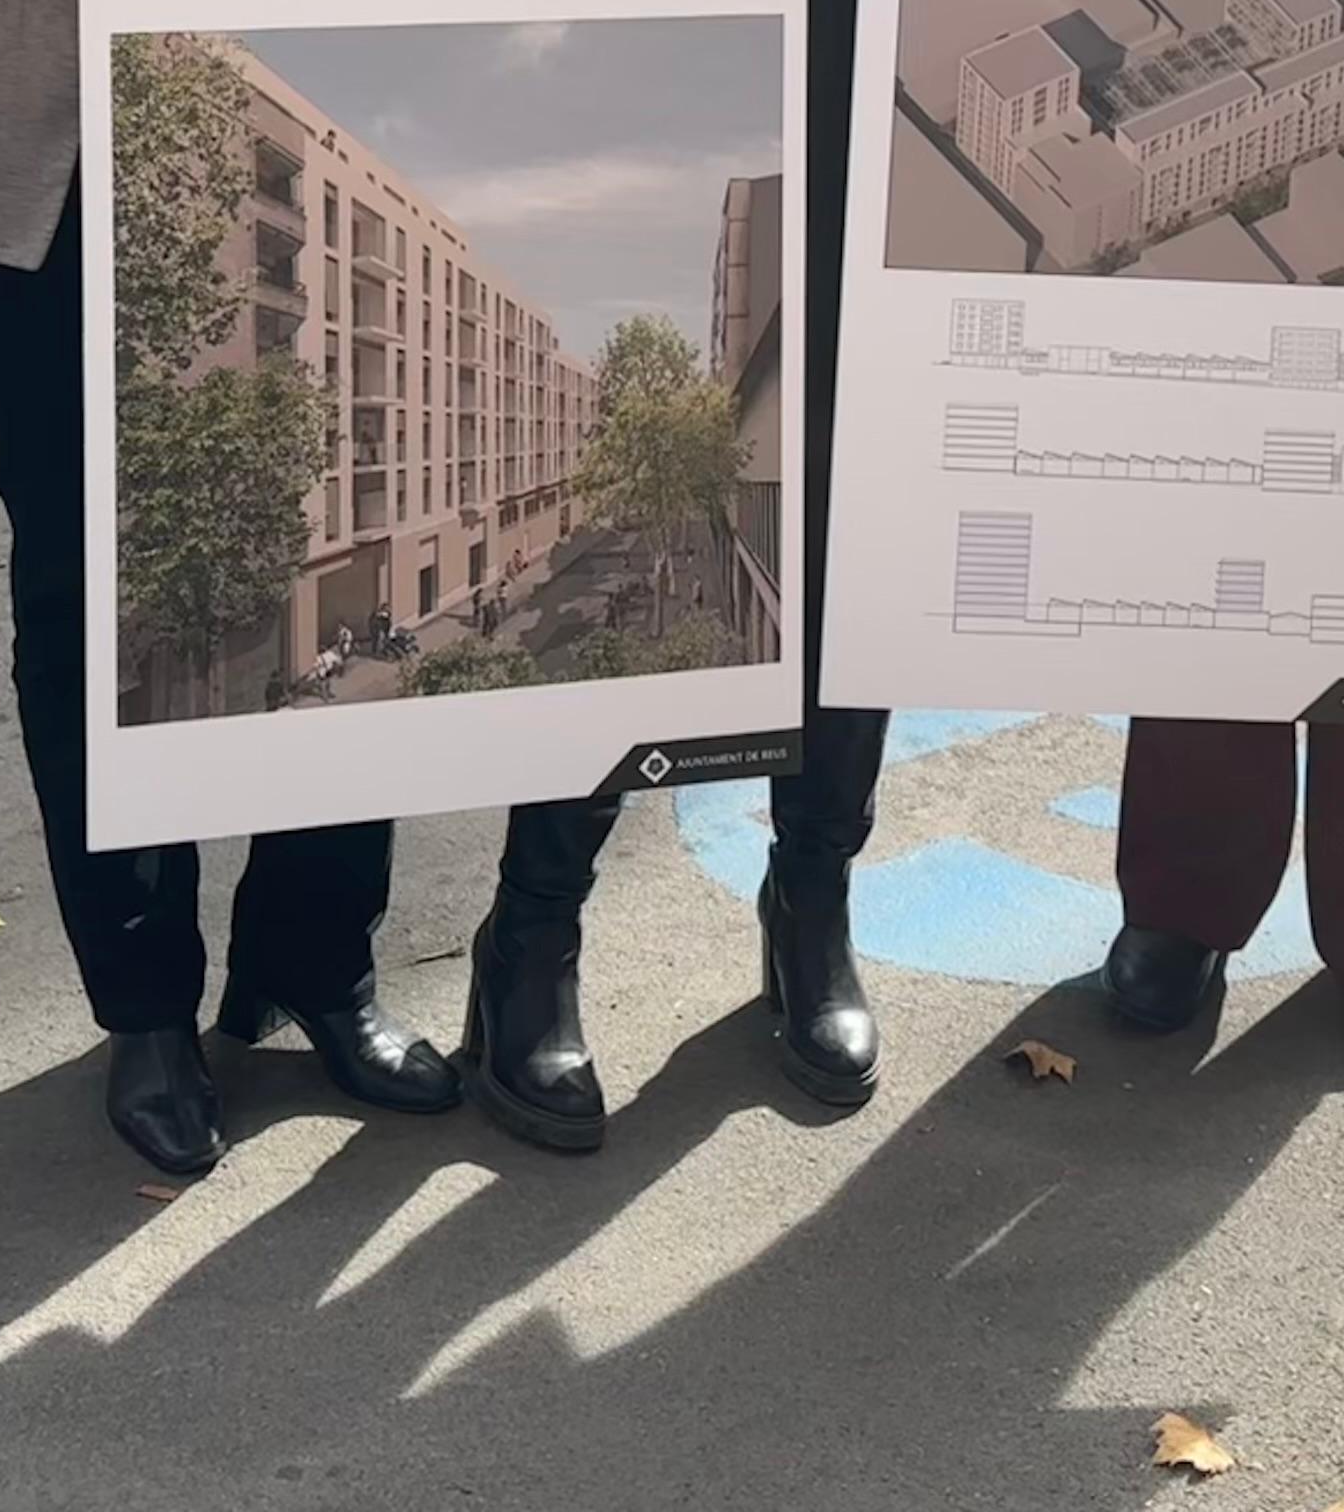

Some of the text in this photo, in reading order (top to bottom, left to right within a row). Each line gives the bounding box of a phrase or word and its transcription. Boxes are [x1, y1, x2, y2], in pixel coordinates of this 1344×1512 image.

[675, 747, 788, 769] AJUNTAMENT DE REUS
